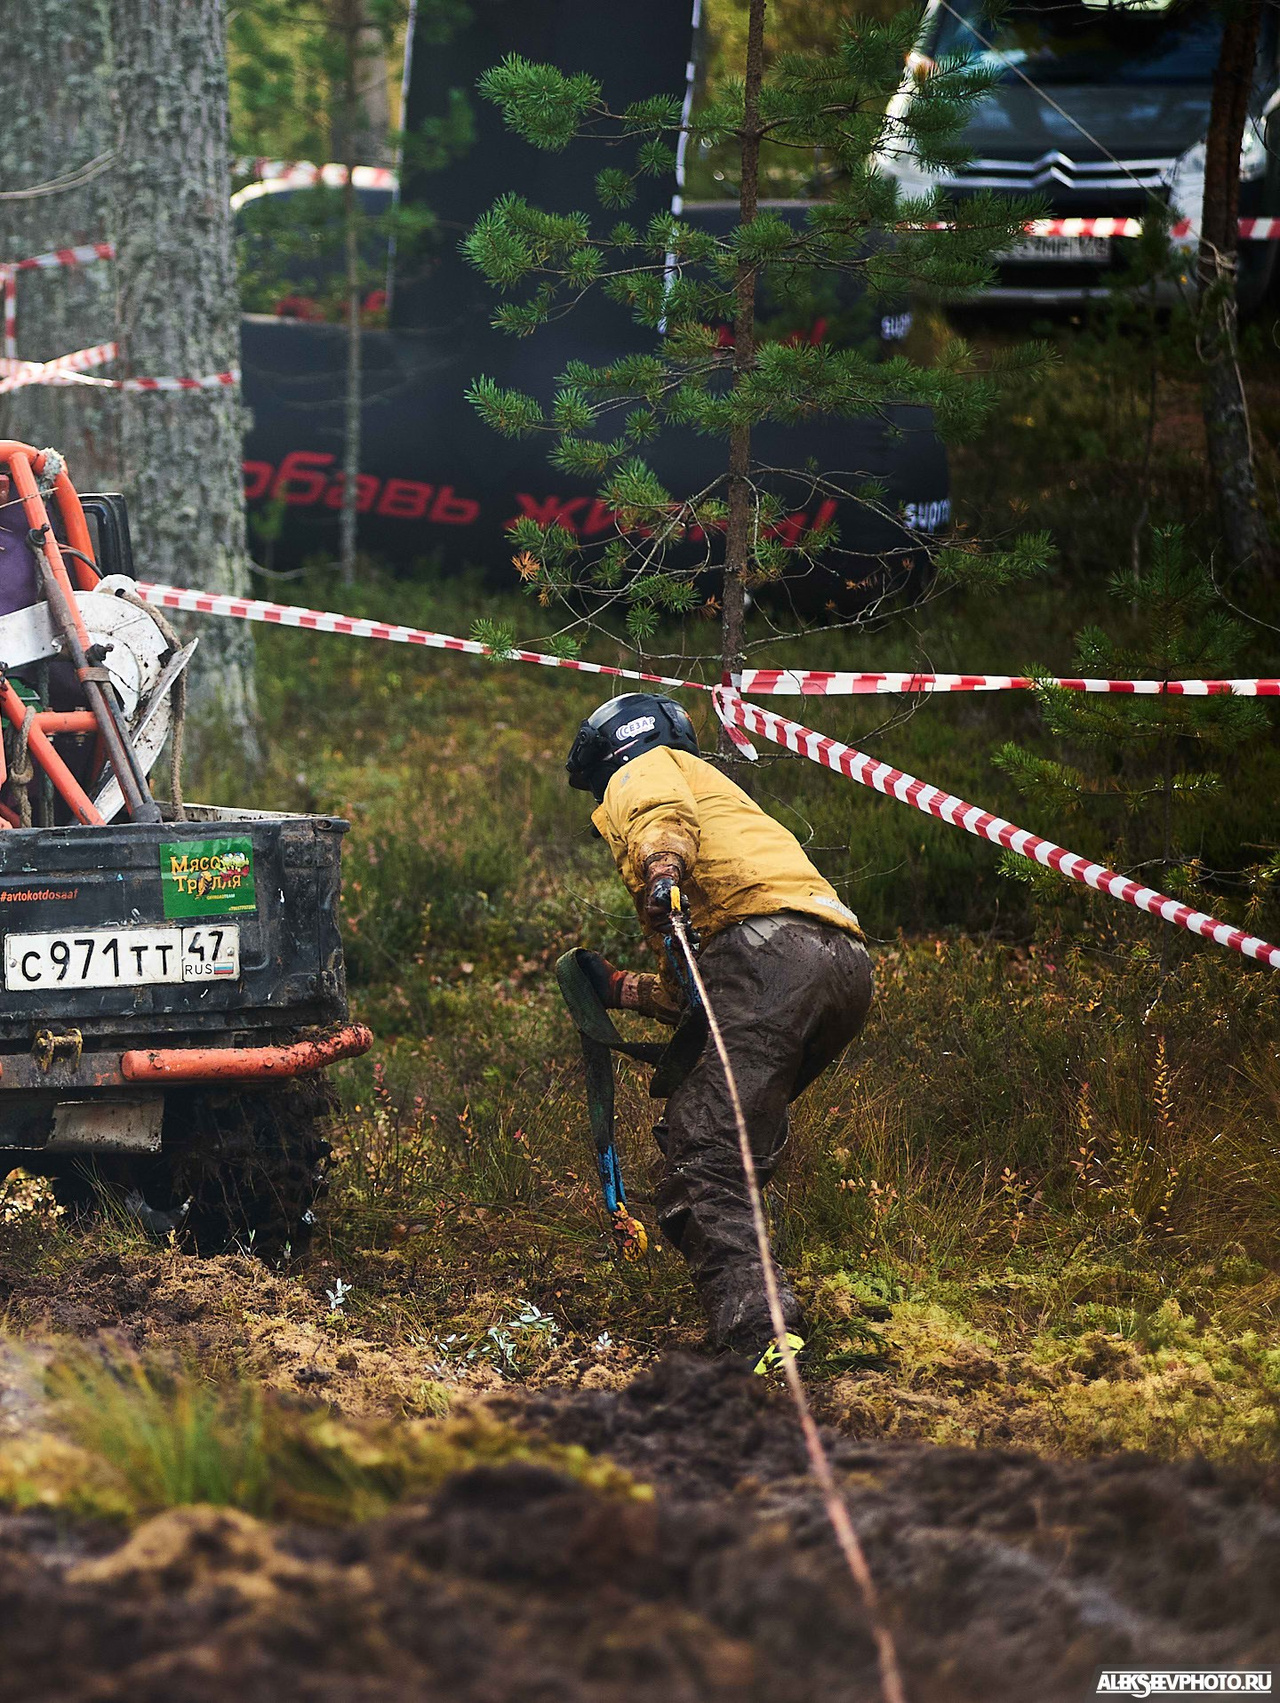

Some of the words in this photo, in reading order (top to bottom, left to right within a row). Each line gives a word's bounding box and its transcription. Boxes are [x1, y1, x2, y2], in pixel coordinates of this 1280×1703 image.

[241, 449, 480, 526] обавь
[0, 888, 79, 903] #avtokotdosaaf
[187, 930, 224, 961] 47
[184, 962, 213, 975] RUS
